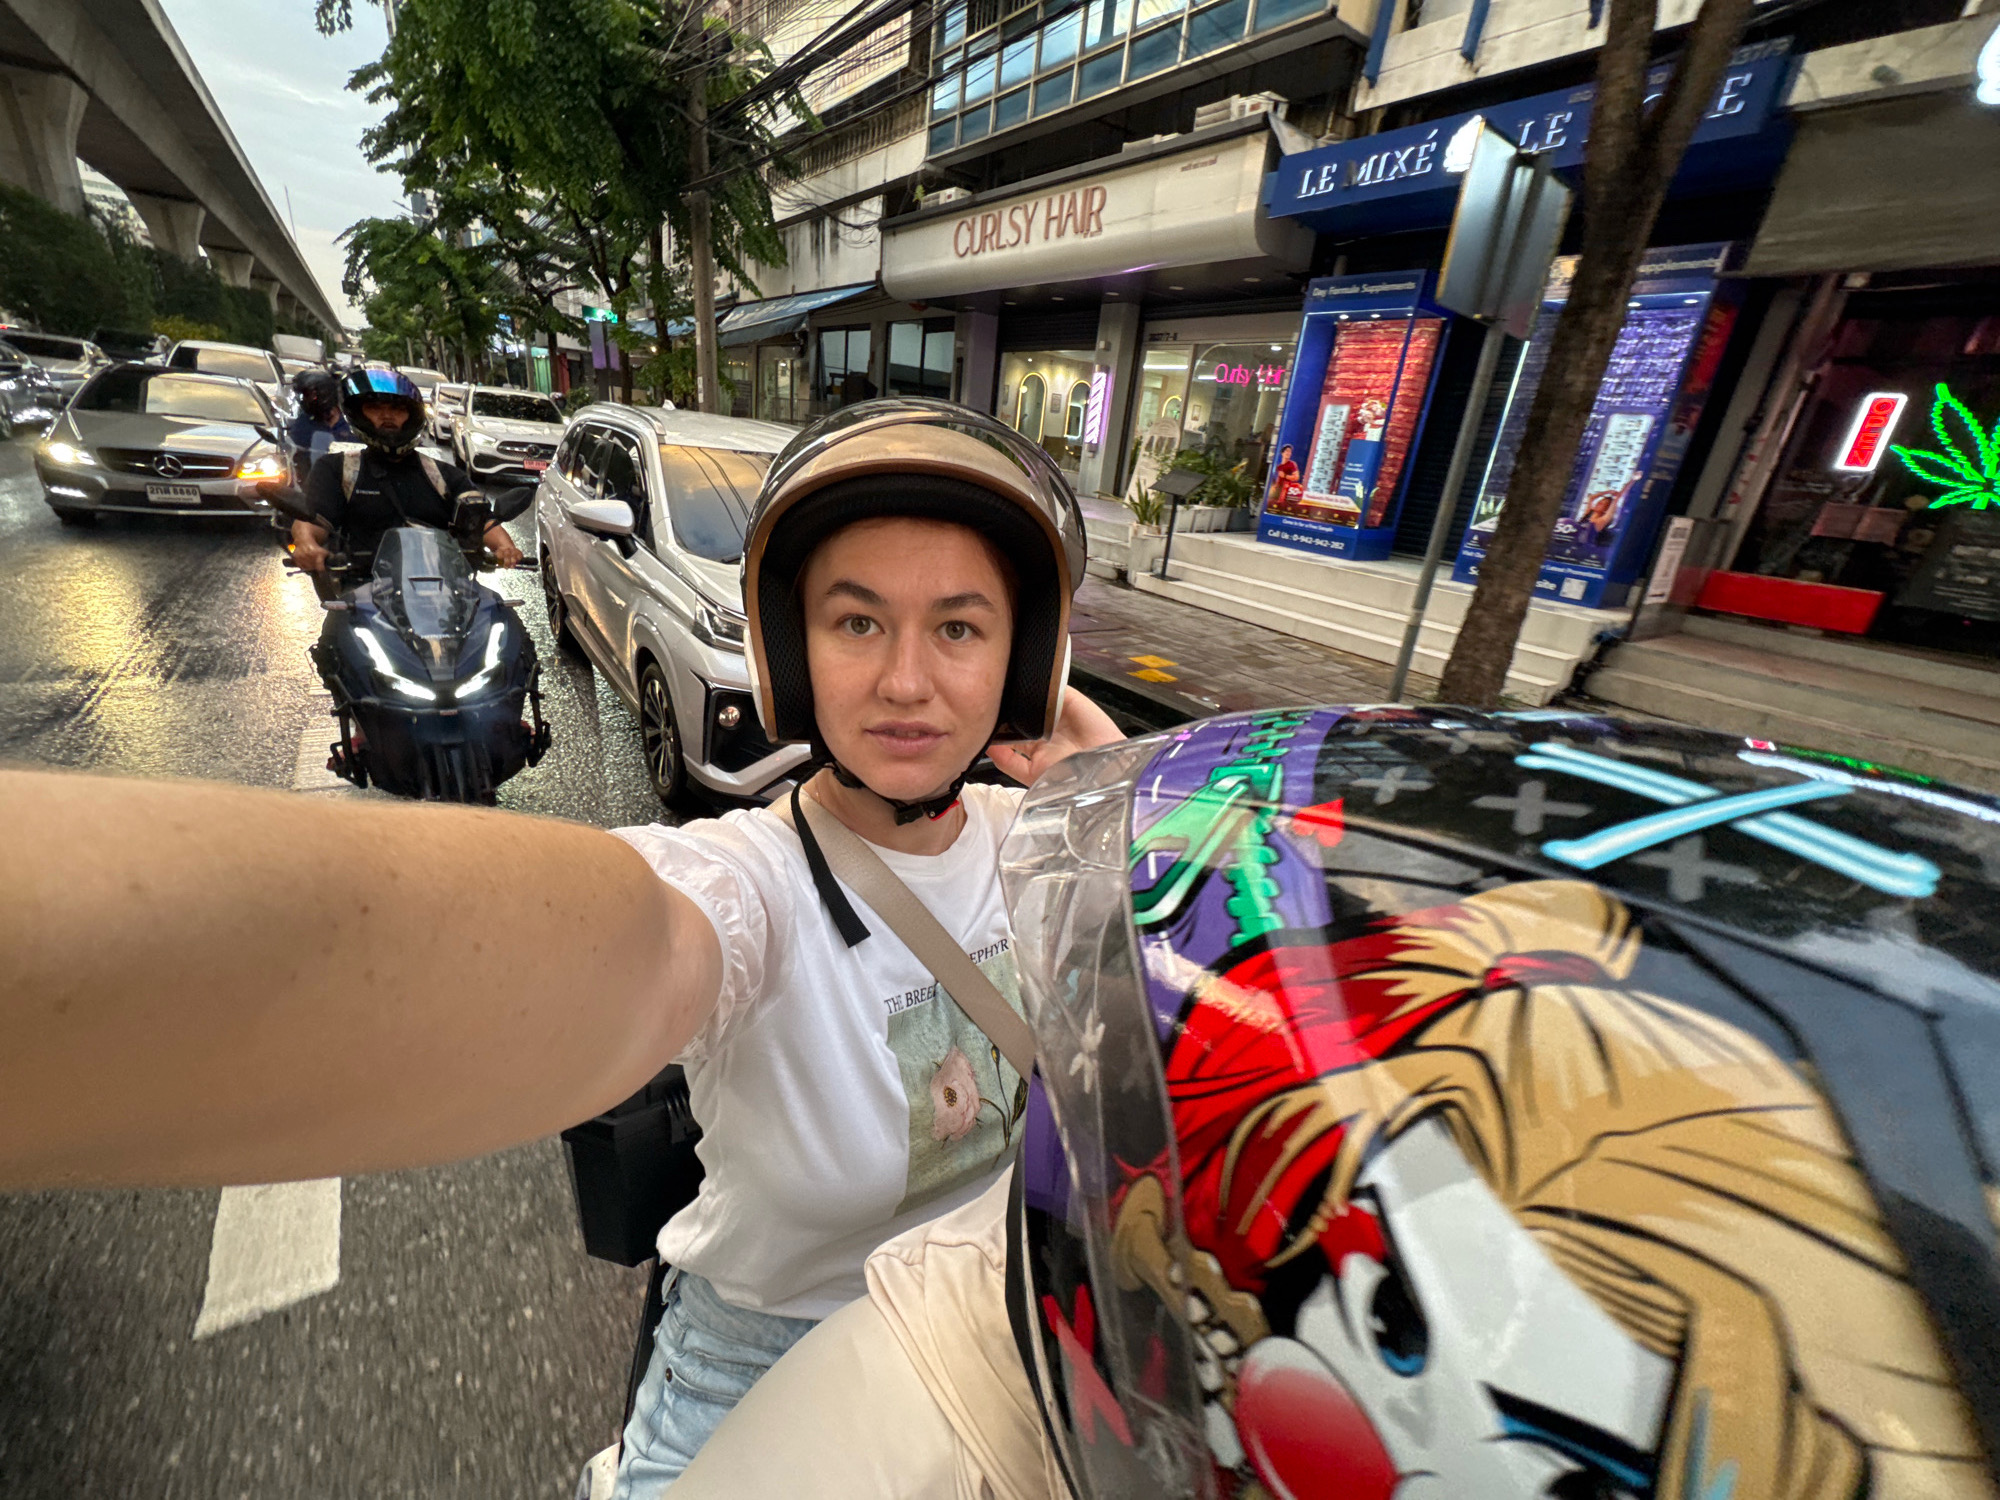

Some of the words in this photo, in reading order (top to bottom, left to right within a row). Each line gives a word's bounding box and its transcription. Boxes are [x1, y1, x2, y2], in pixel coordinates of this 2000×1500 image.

[1297, 163, 1338, 199] LE
[1342, 128, 1438, 187] MIXÉ
[953, 201, 1039, 258] CURLSY
[1043, 185, 1107, 240] HAIR
[1636, 257, 1722, 276] upplements
[1361, 281, 1417, 294] Supplements
[1846, 398, 1898, 466] OPEN
[1267, 529, 1280, 538] Call
[969, 938, 1009, 965] EPHYR
[884, 994, 905, 1014] THE
